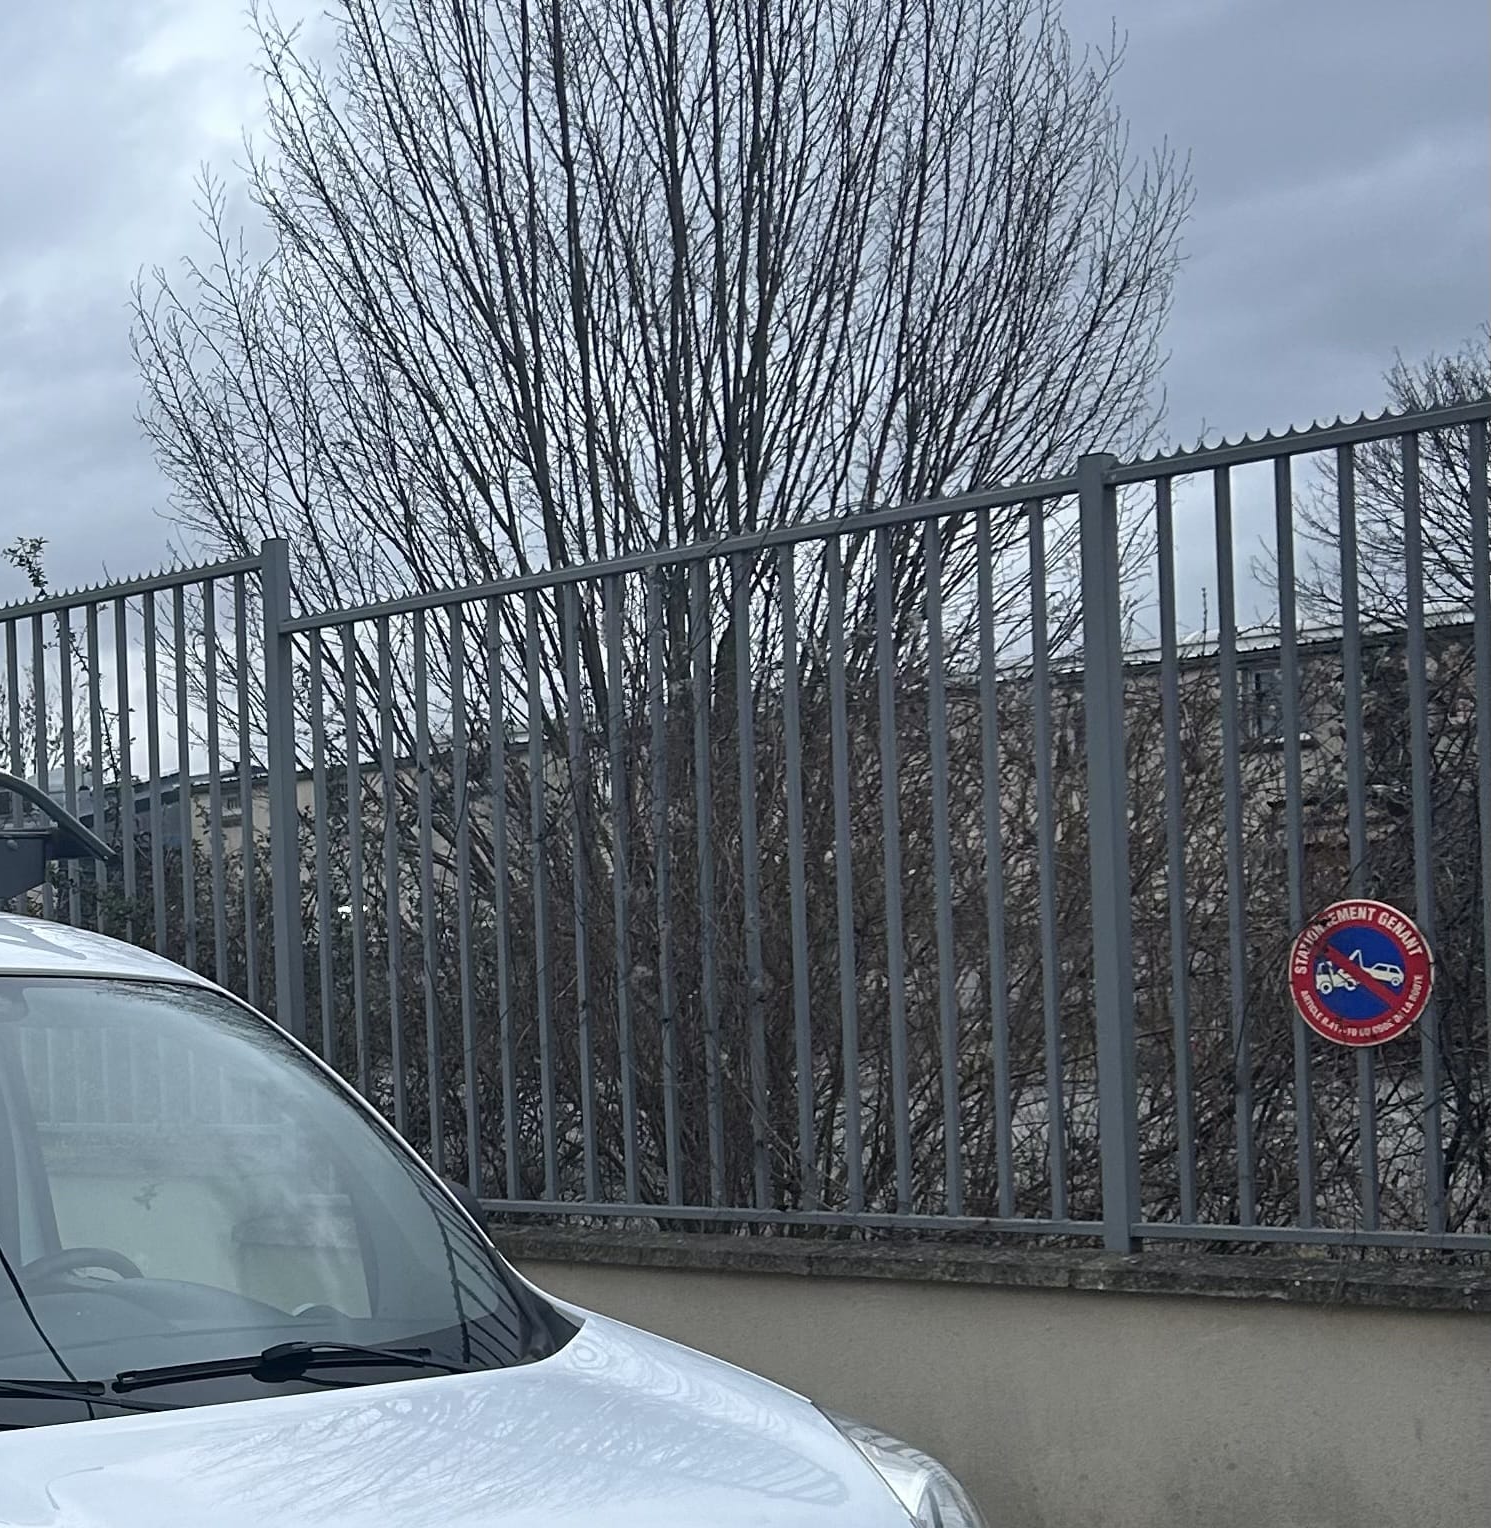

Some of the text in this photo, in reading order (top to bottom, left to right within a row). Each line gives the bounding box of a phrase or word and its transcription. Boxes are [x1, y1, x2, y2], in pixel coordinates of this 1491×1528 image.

[1294, 906, 1423, 975] STATIONEMENT GENANT
[1301, 990, 1324, 1021] ARTICLE
[1401, 1001, 1415, 1014] LA
